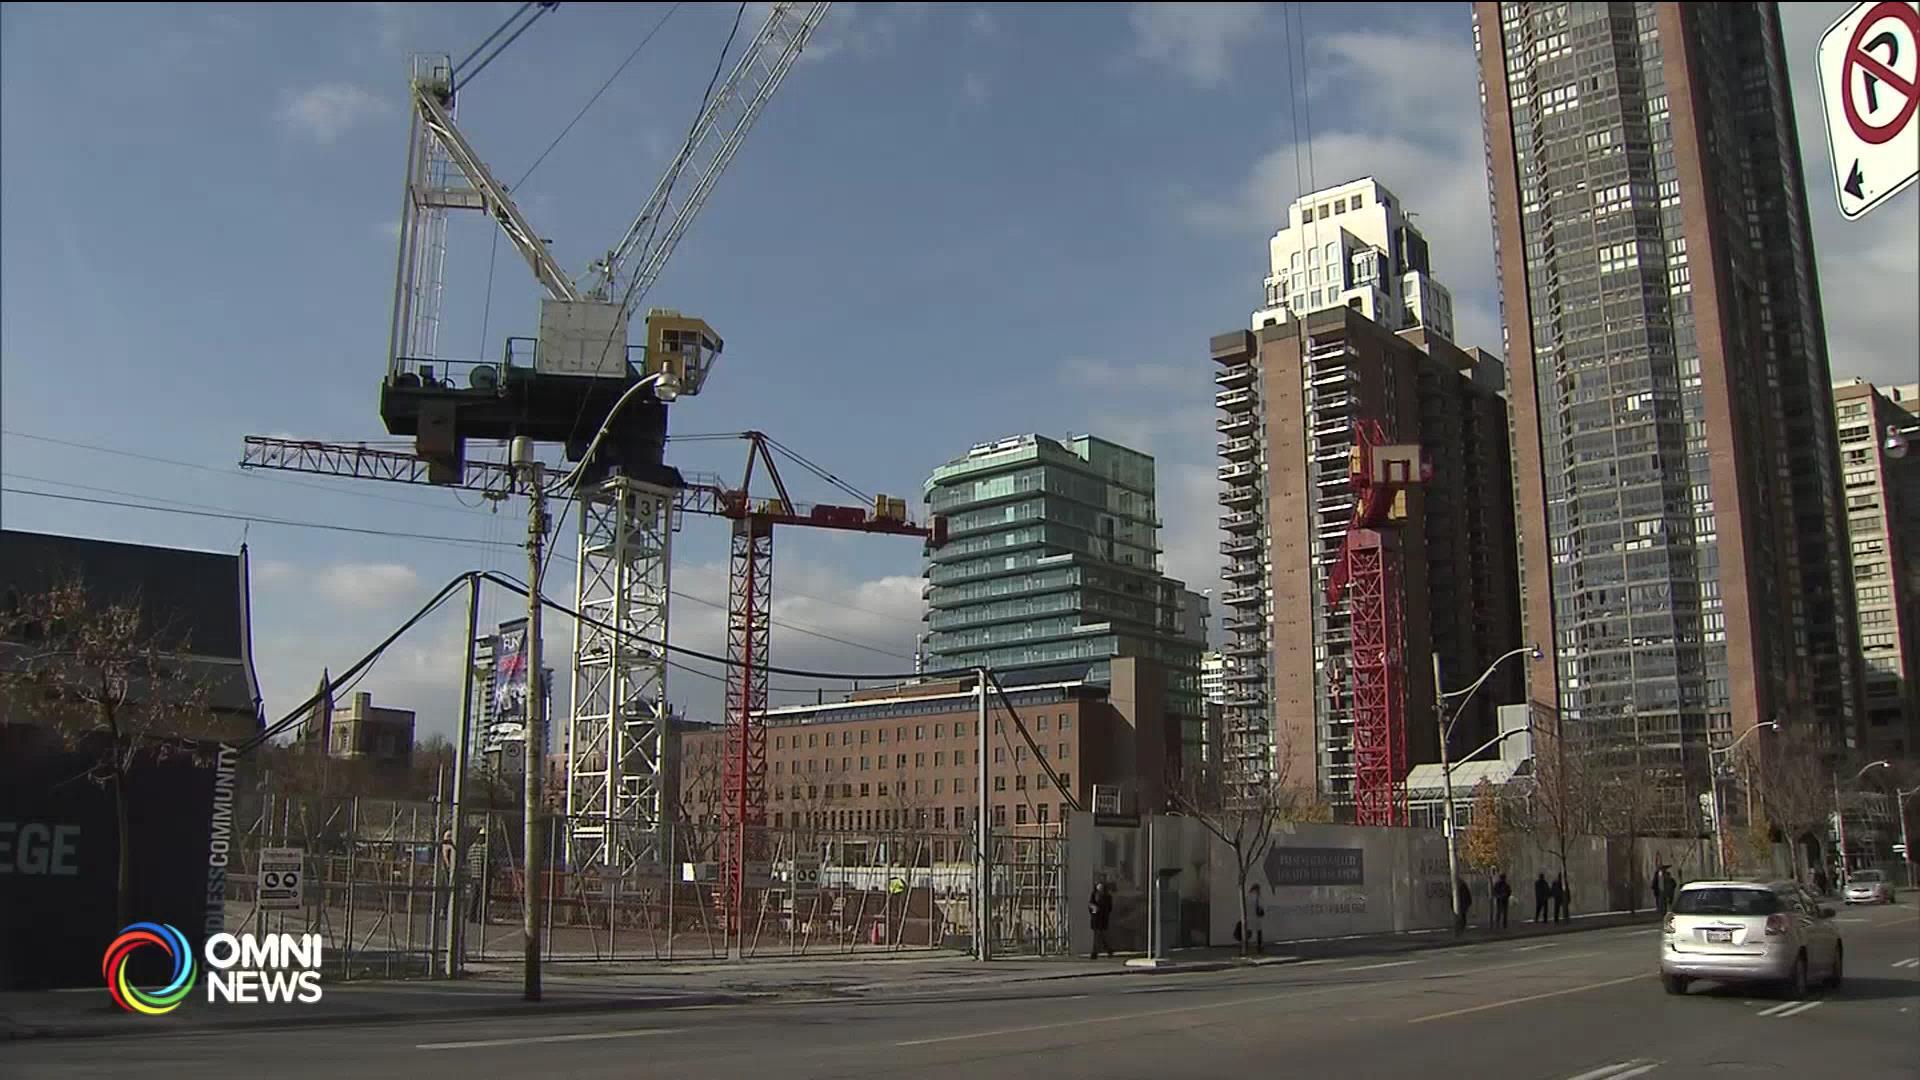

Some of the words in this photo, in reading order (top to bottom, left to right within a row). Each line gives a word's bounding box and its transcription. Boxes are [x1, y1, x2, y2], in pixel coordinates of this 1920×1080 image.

[641, 501, 651, 516] 3
[209, 742, 237, 867] COMMUNITY
[0, 822, 80, 874] EGE
